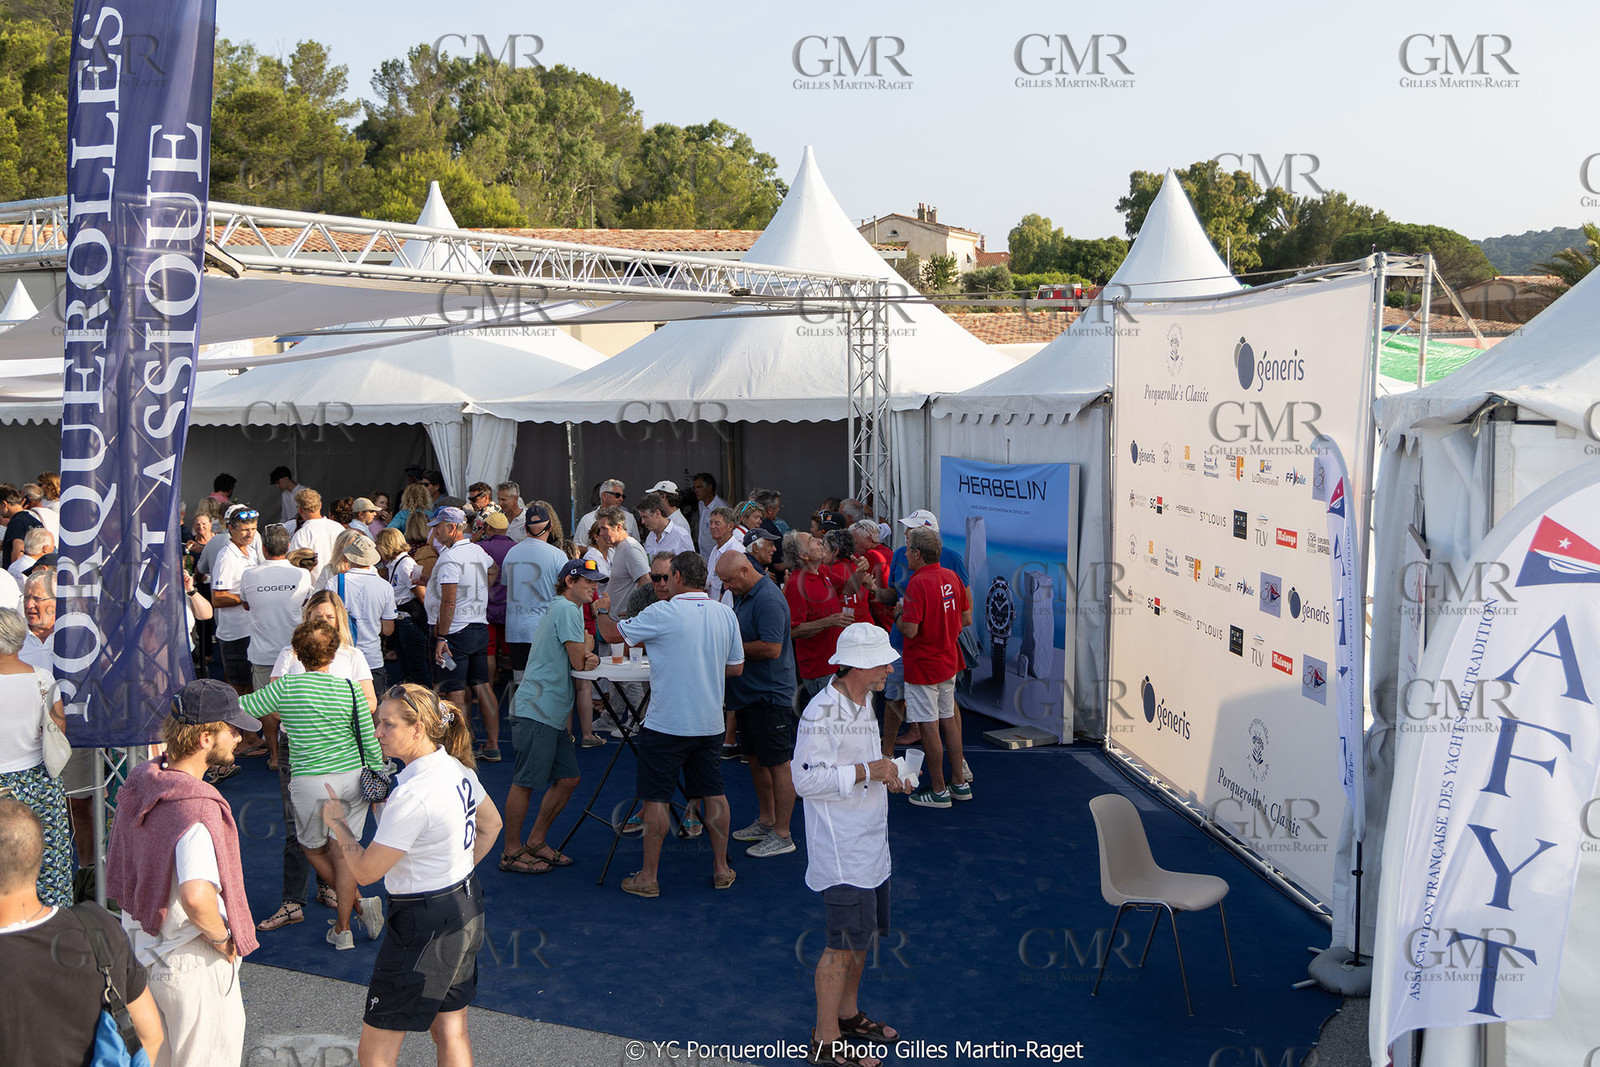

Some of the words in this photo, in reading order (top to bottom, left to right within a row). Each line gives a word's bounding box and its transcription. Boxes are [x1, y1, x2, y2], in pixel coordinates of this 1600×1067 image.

[52, 6, 124, 722] PORQUEROLLES
[1144, 384, 1184, 405] Porquerolle's
[1185, 384, 1209, 403] Classic
[958, 474, 1047, 501] HERBELIN
[941, 584, 954, 597] 12
[943, 599, 956, 613] F1
[1463, 597, 1499, 689] TRADITION
[1458, 689, 1474, 713] DE
[1443, 716, 1468, 780] YACHTS
[456, 777, 476, 814] 12
[1217, 766, 1267, 815] Porquerolle's
[1269, 802, 1300, 837] Classic
[1439, 780, 1454, 811] DES
[1425, 816, 1449, 900] FRANÇAISE
[1408, 902, 1435, 1000] ASSOCIATION
